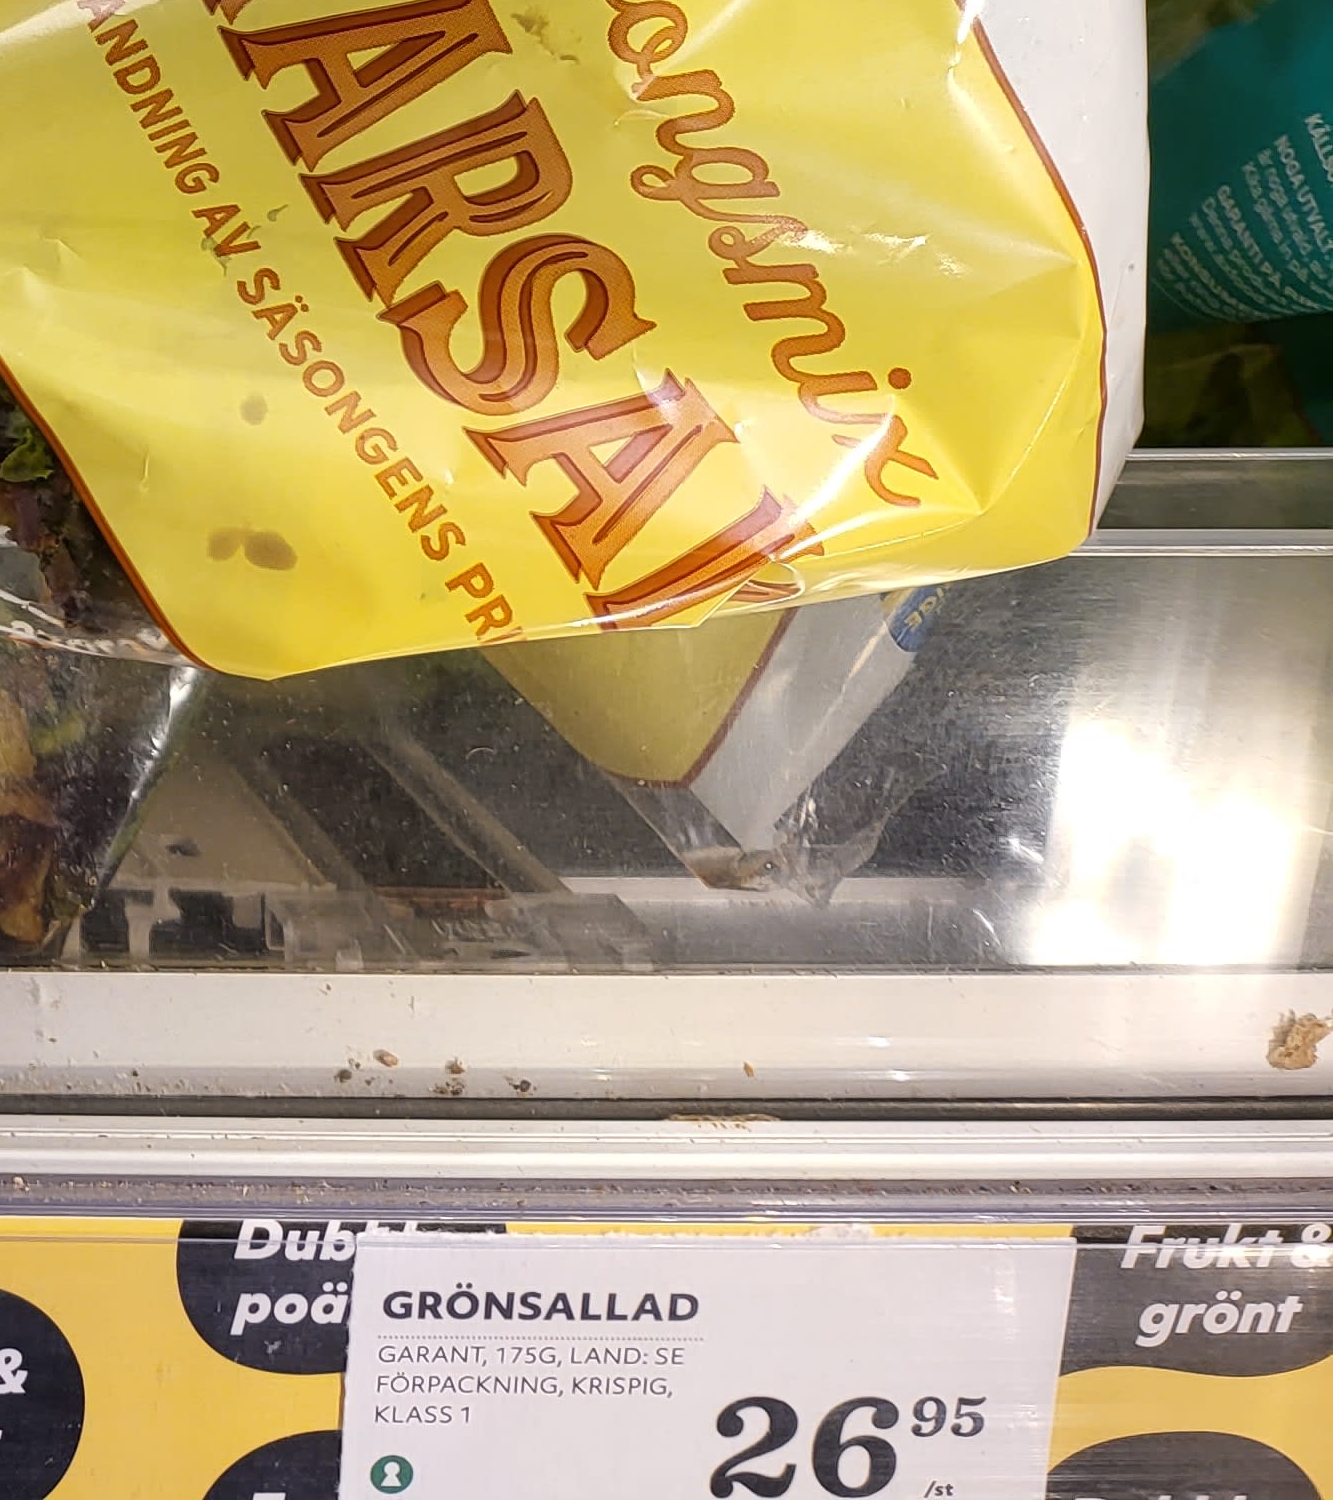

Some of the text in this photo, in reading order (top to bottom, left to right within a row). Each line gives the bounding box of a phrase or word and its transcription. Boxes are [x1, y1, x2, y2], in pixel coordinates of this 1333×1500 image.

[192, 204, 261, 258] AV
[236, 267, 466, 561] SÄSONGENS
[1121, 1225, 1284, 1269] Frukt
[383, 1282, 699, 1322] GRÖNSALLAD
[1135, 1290, 1303, 1348] grönt
[378, 1345, 685, 1367] GARANT, 175G, LAND: SE
[376, 1372, 673, 1398] FÖRPACKNING, KRISPIG,
[374, 1405, 471, 1424] KLASS 1
[709, 1397, 987, 1500] 26 95
[924, 1481, 954, 1500] /st
